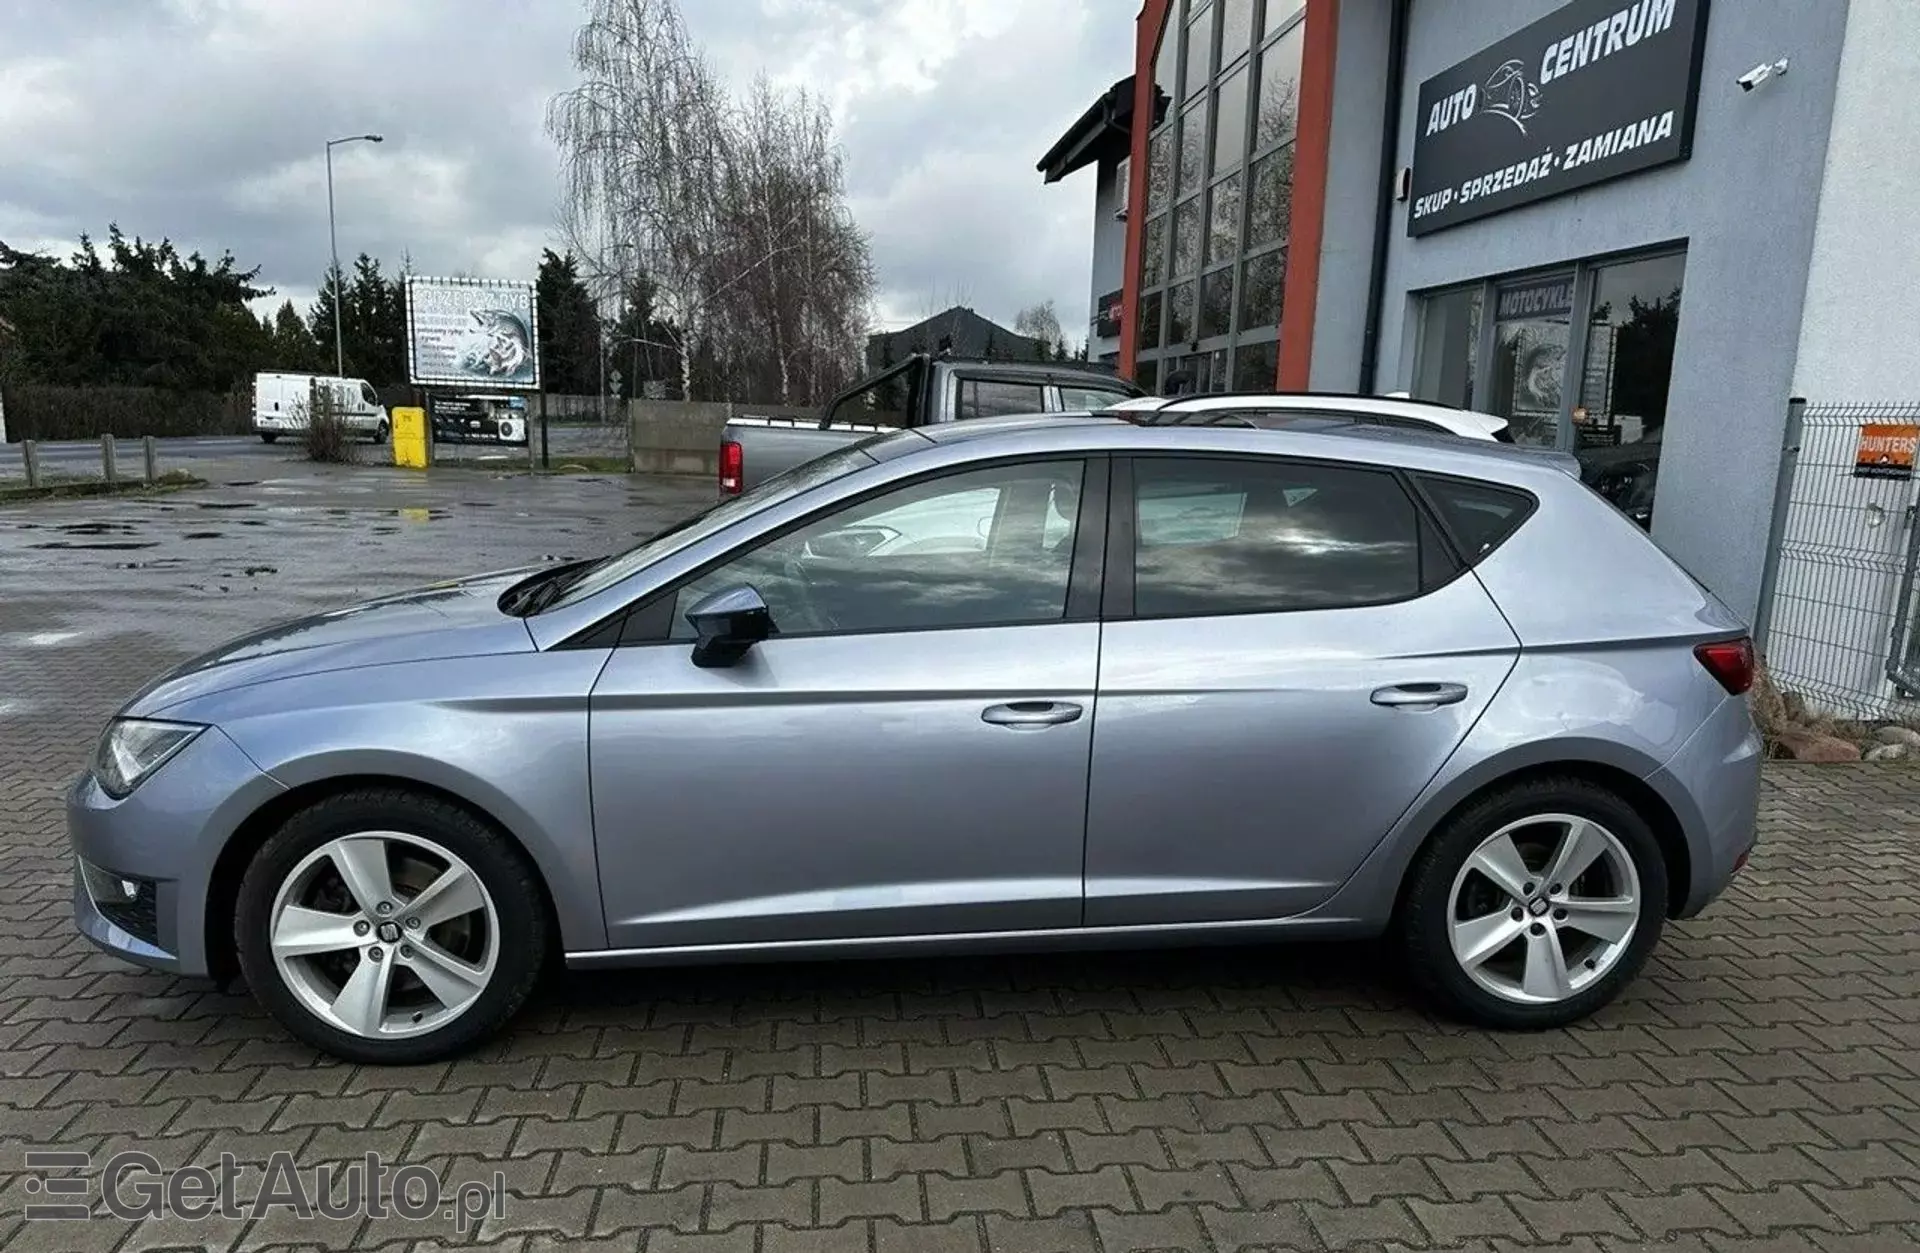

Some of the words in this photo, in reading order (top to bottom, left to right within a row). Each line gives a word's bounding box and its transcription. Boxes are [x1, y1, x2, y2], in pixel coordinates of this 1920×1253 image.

[1426, 84, 1477, 137] AUTO
[1540, 0, 1677, 85] CENTRUM
[1413, 187, 1453, 220] SKUP
[1459, 147, 1553, 205] SPRZEDAŻ
[1562, 110, 1674, 171] ZAMIANA
[1860, 435, 1917, 454] HUNTERS
